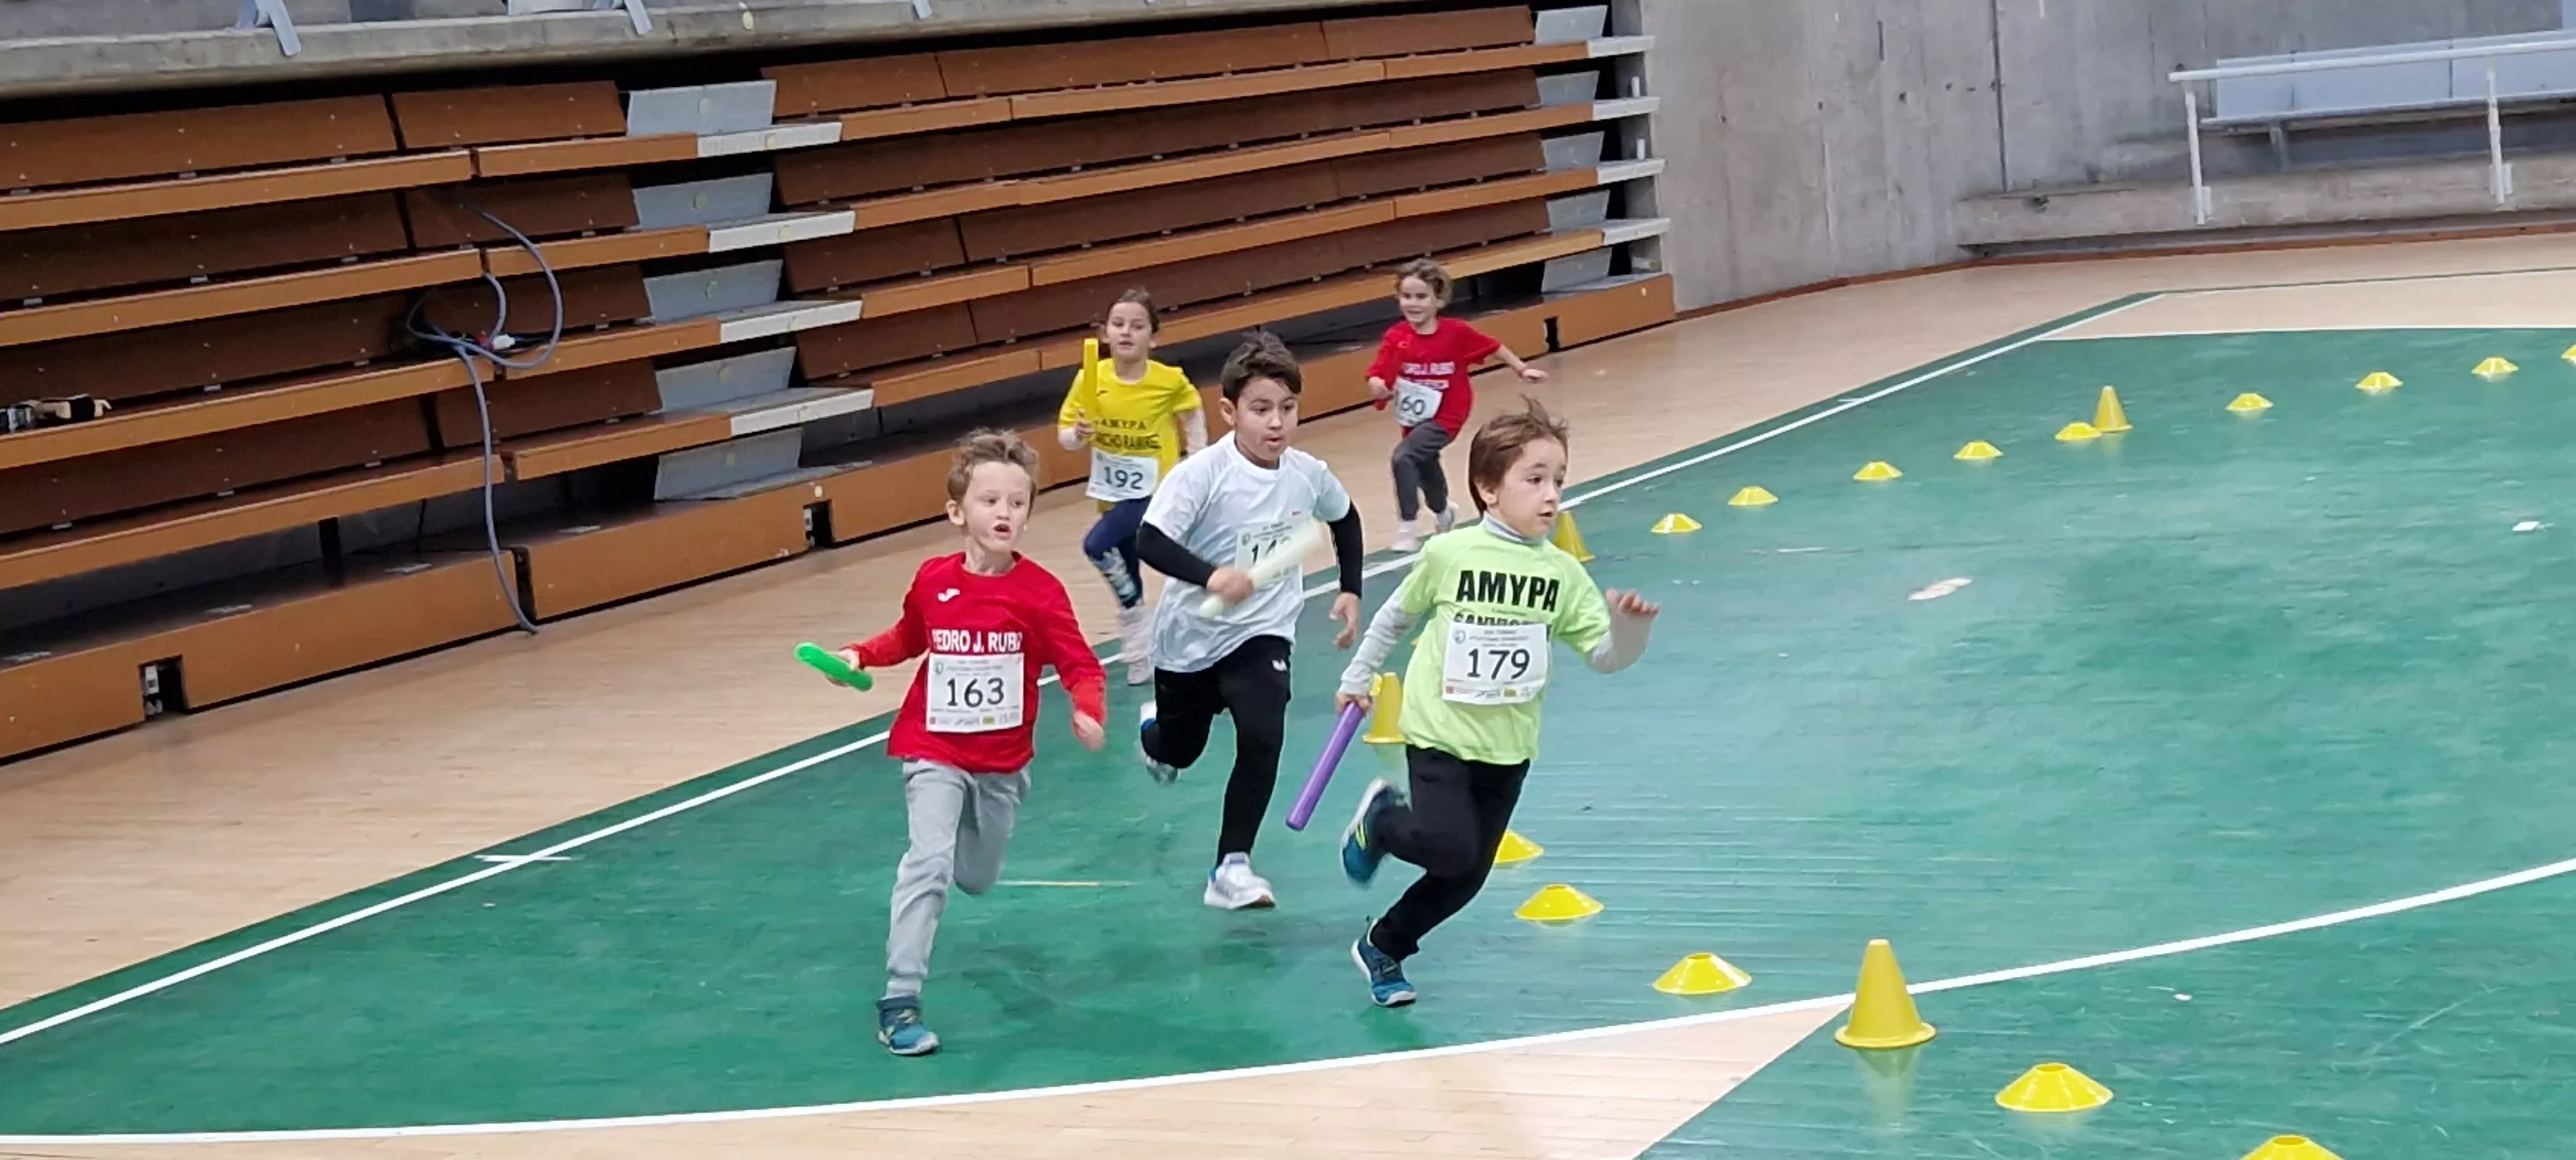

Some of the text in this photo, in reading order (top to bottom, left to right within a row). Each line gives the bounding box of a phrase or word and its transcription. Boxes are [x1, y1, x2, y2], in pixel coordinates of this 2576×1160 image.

[1104, 466, 1143, 490] 192
[1455, 569, 1561, 613] AMYPA
[973, 631, 985, 653] J.
[1467, 648, 1530, 680] 179
[947, 677, 1005, 708] 163
